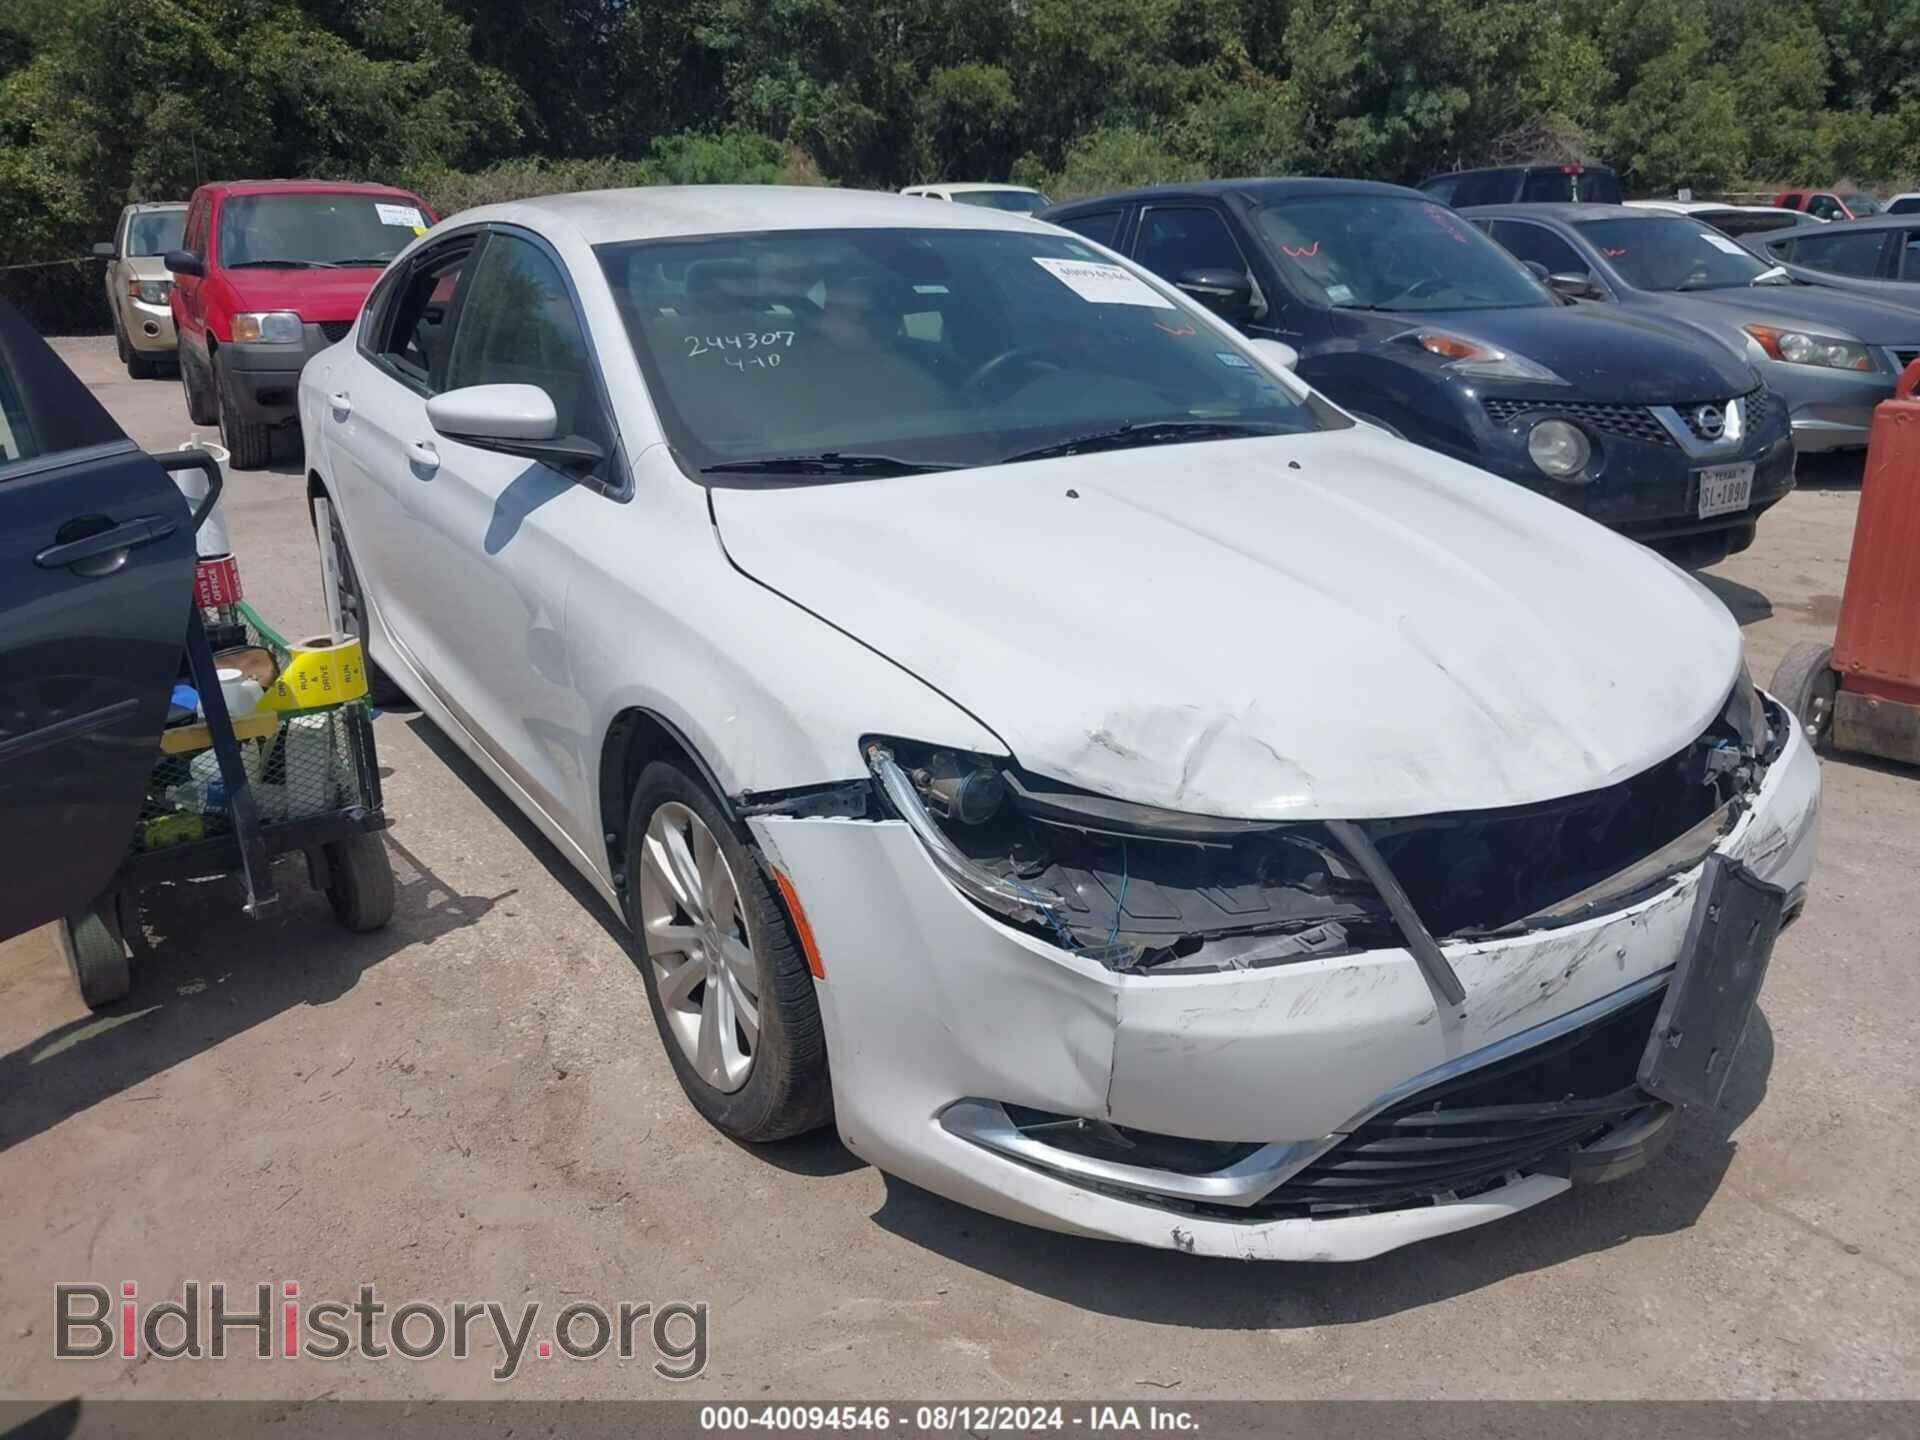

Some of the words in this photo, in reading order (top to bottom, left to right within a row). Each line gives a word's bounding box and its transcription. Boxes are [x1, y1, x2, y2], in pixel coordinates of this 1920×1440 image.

[684, 330, 796, 358] 244307
[200, 580, 211, 605] KEYS
[207, 568, 222, 601] OFFICE
[298, 671, 309, 691] RUN
[320, 664, 332, 692] DRIVE
[343, 664, 353, 684] RUN
